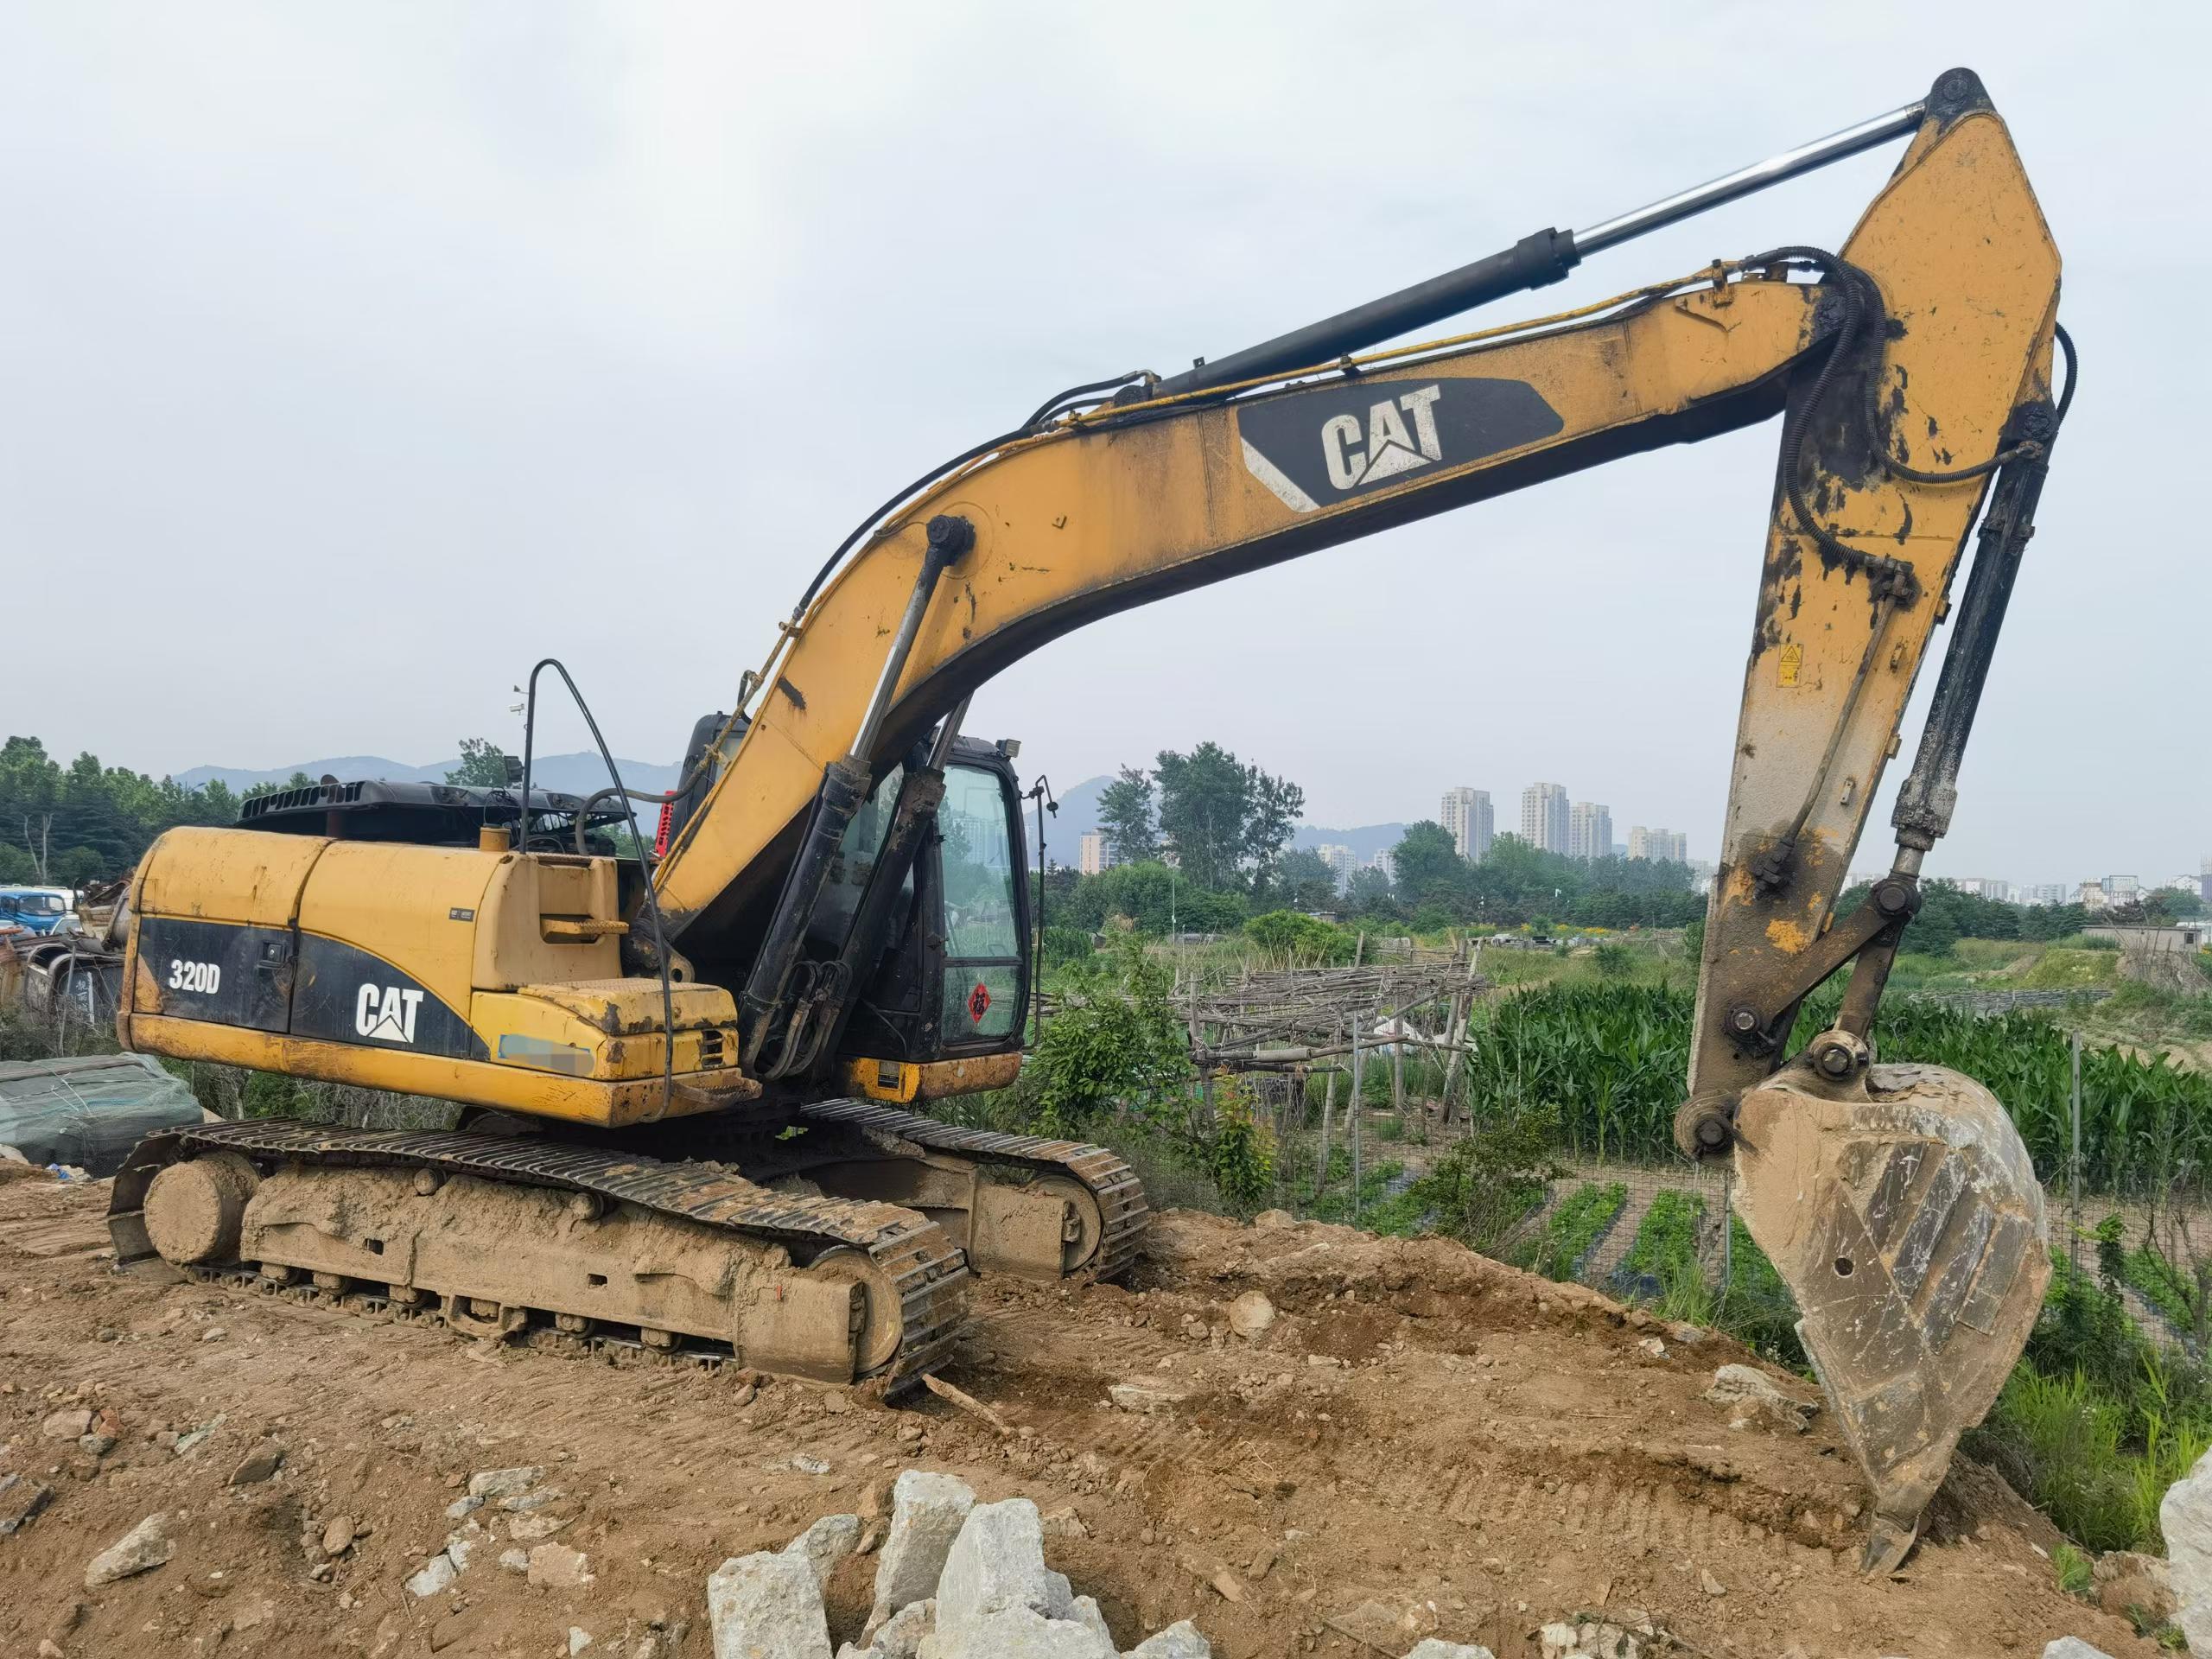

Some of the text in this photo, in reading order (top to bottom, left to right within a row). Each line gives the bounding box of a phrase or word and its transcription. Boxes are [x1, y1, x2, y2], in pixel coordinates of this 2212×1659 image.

[1321, 385, 1442, 490] CAT
[168, 959, 220, 995] 320D
[356, 983, 423, 1043] CAT
